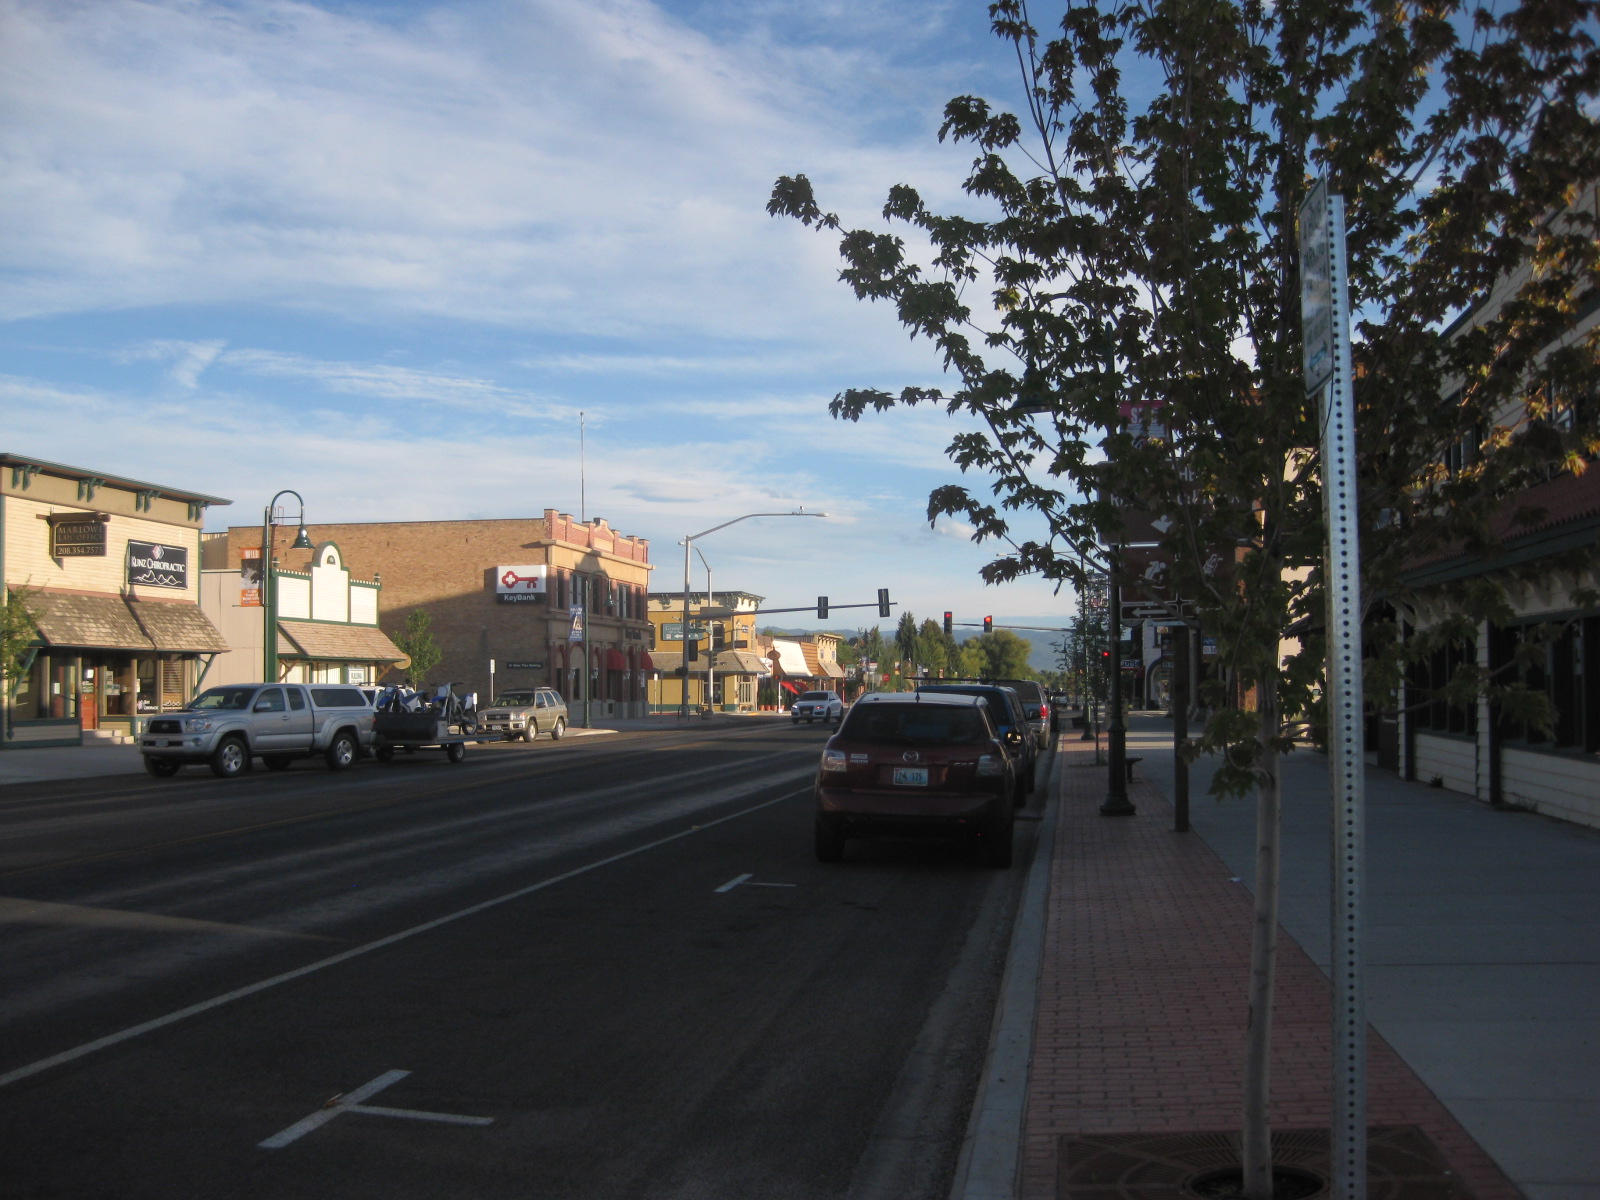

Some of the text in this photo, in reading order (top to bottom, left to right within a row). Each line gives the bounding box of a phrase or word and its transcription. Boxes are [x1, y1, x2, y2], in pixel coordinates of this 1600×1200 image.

[58, 526, 103, 534] MARLOWE
[58, 533, 103, 542] LAW OFFICE
[58, 546, 104, 555] 208.354.7575
[131, 556, 185, 572] KUNZ CHIROPRACTIC
[504, 594, 536, 603] KeyBank
